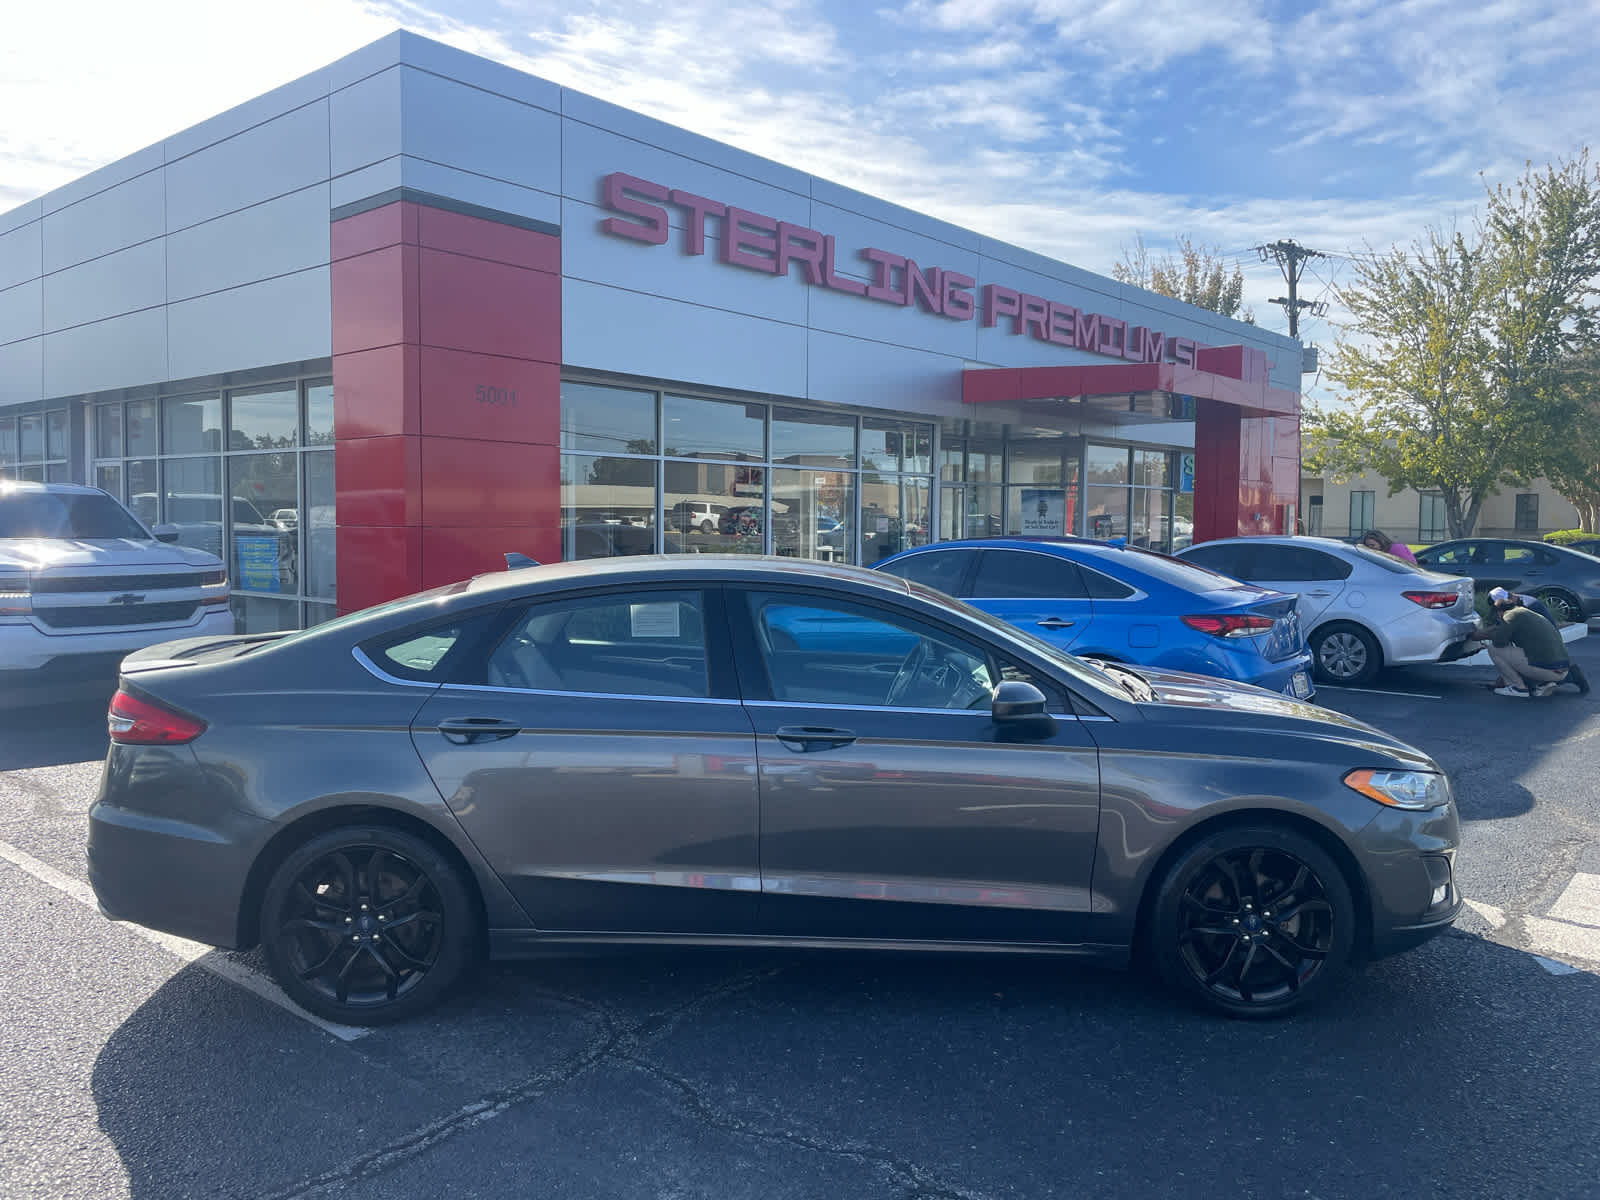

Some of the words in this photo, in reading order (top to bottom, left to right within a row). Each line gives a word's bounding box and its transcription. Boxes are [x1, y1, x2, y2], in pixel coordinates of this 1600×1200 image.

[602, 172, 974, 320] STERLING
[984, 284, 1165, 363] PREMIUM
[475, 384, 516, 408] 5001
